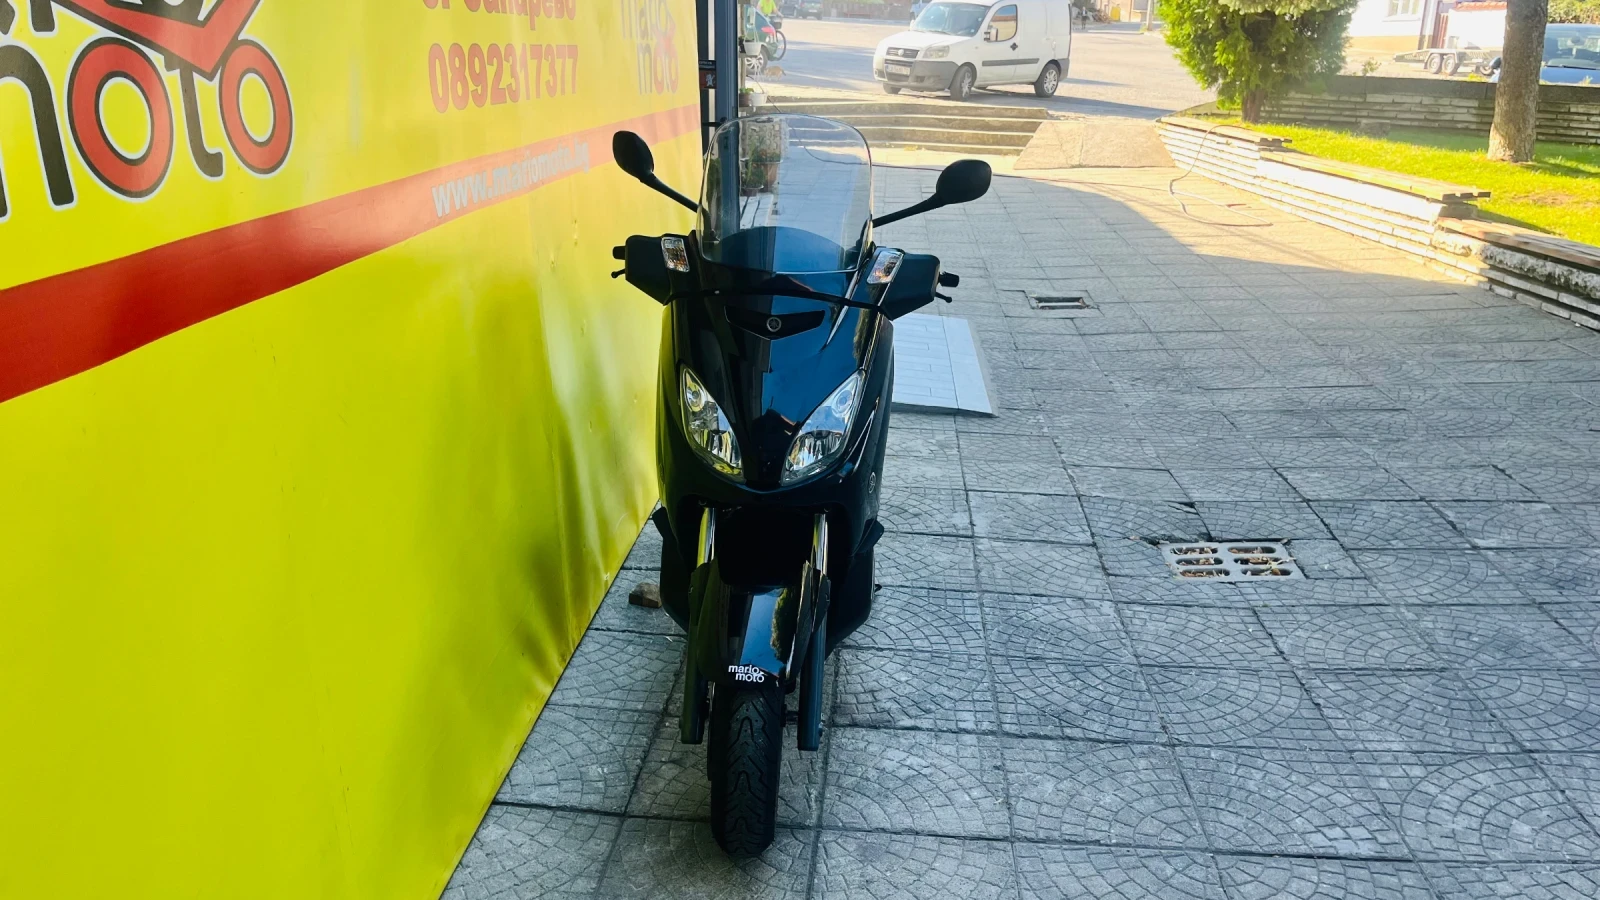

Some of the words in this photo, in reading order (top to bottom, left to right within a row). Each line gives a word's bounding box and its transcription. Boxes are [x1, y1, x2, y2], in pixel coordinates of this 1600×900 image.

[428, 42, 579, 113] 0892317377
[431, 138, 590, 218] www.mariomoto.bg
[735, 673, 765, 683] moto
